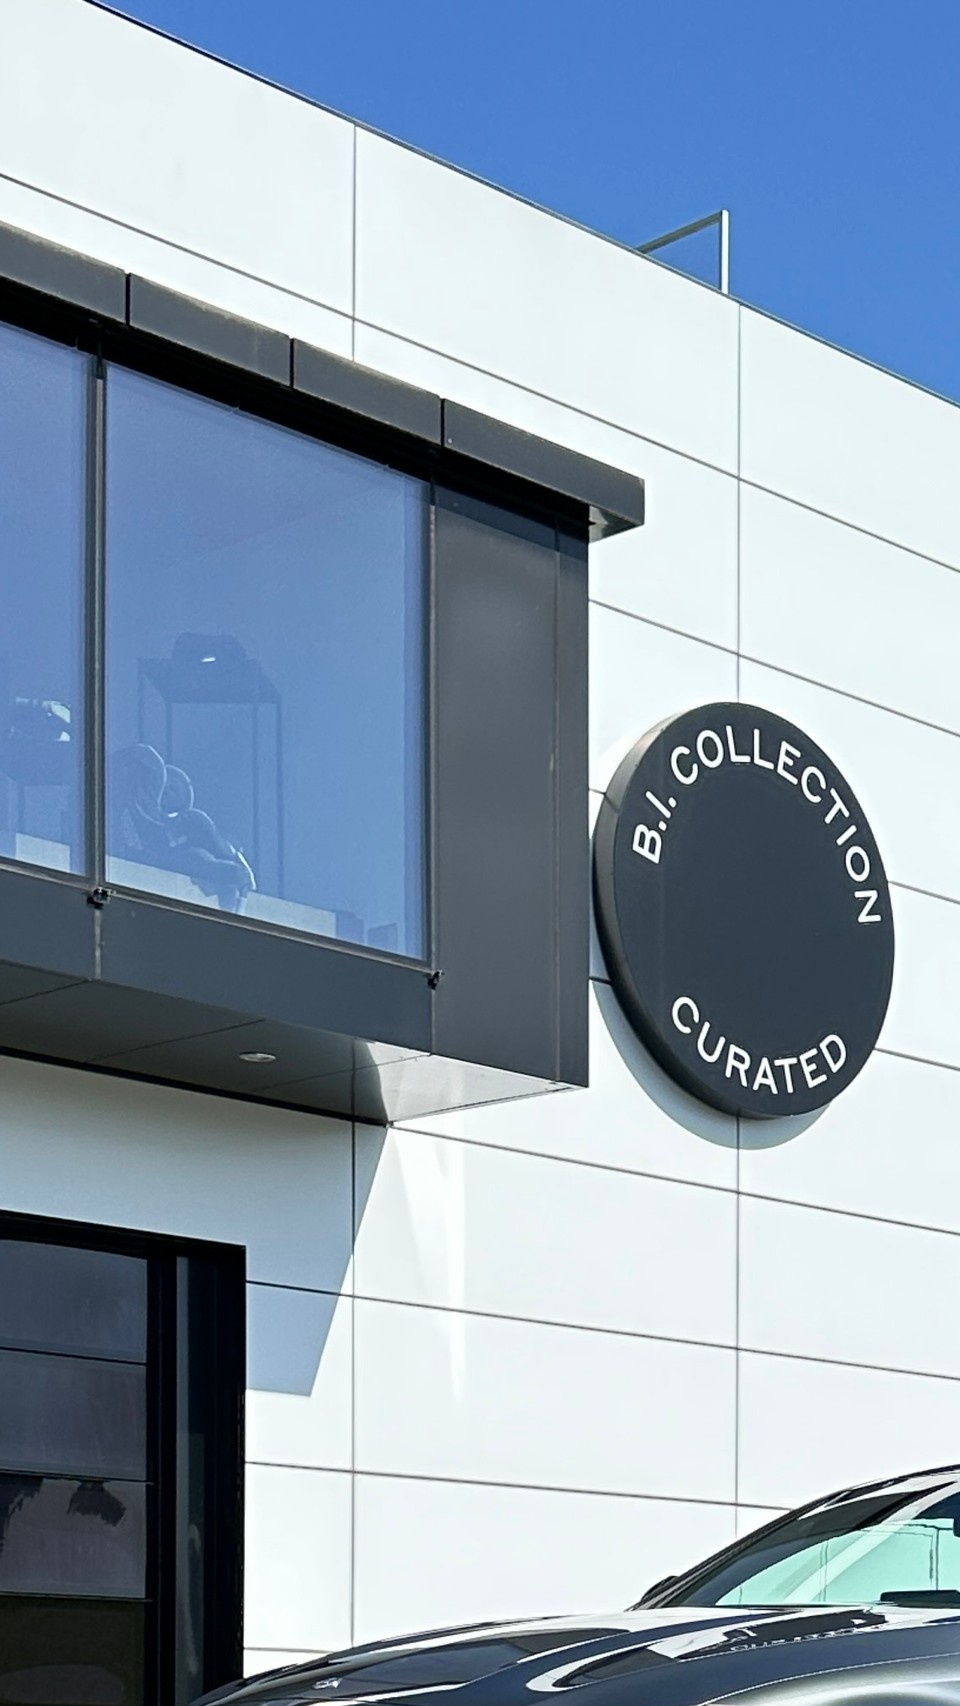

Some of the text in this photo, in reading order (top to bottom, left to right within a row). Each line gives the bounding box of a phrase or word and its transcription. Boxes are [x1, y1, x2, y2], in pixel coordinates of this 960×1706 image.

[632, 725, 882, 923] B.I. COLLECTION
[671, 996, 848, 1095] CURATED
